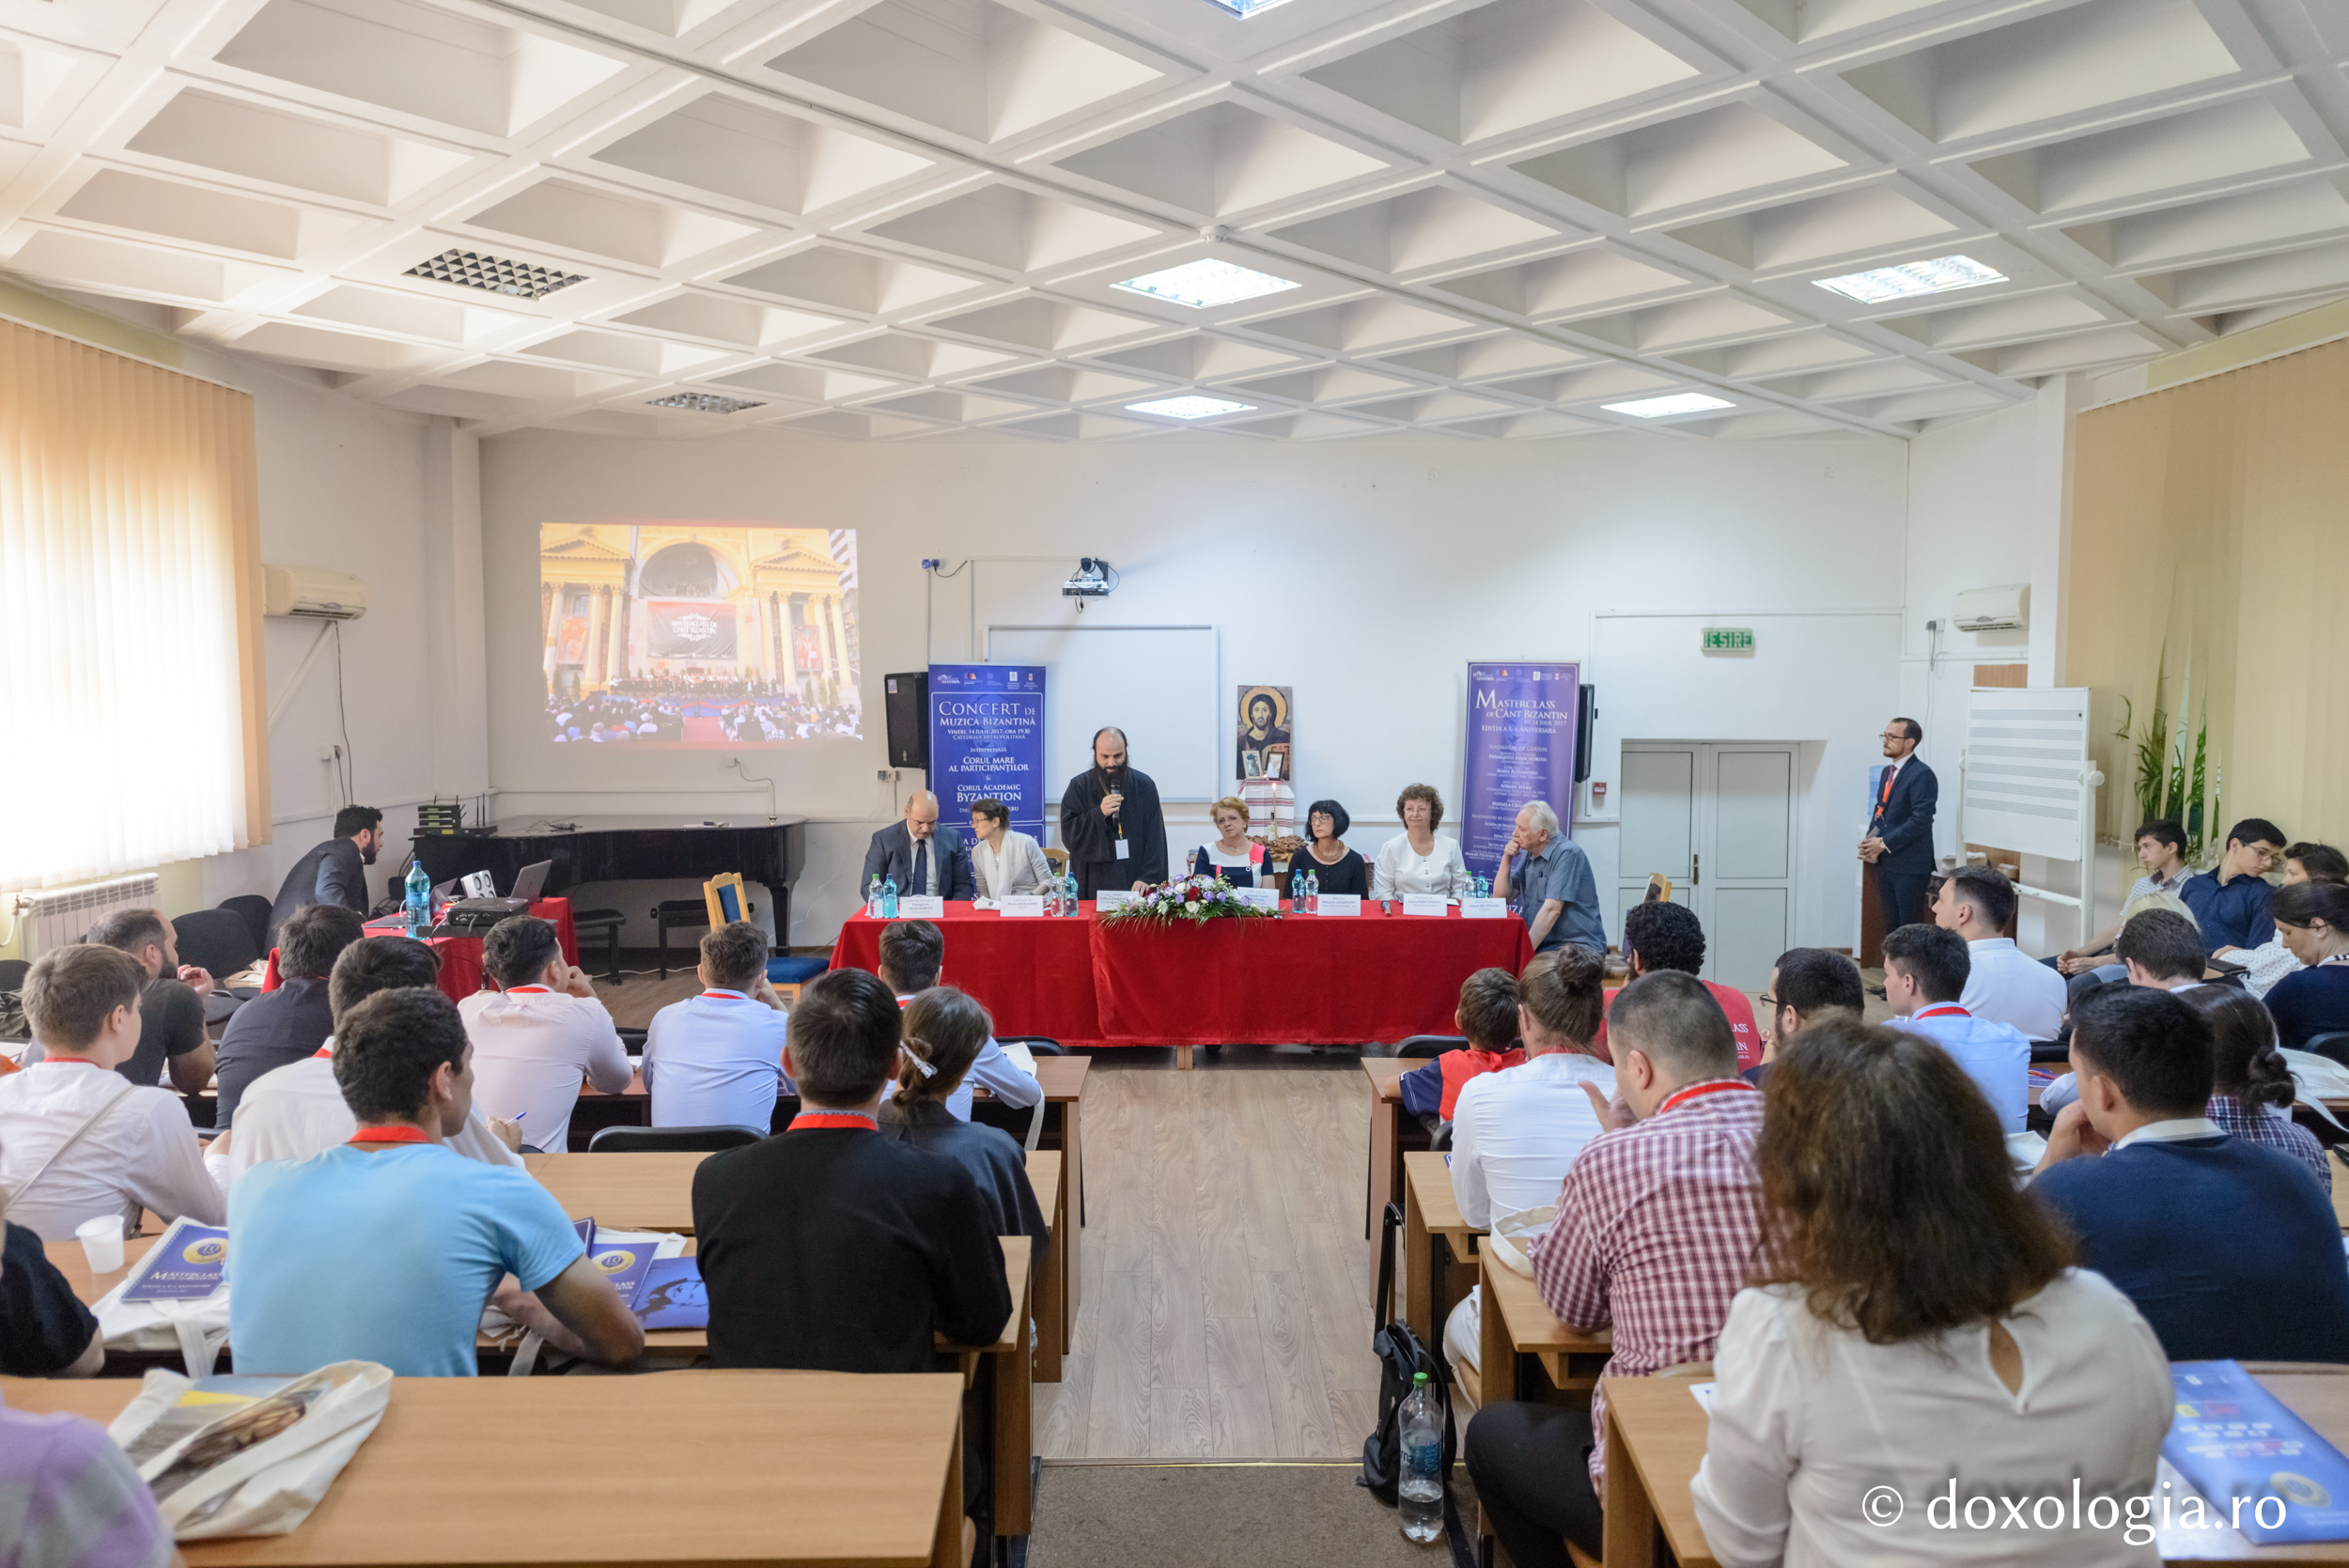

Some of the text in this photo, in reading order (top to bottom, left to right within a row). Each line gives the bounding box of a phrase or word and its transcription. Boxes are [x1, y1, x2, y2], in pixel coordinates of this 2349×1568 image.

[1475, 688, 1556, 709] MASTERCLASS
[939, 701, 1036, 716] CONCERT DE
[1524, 710, 1567, 720] BIZANTIN
